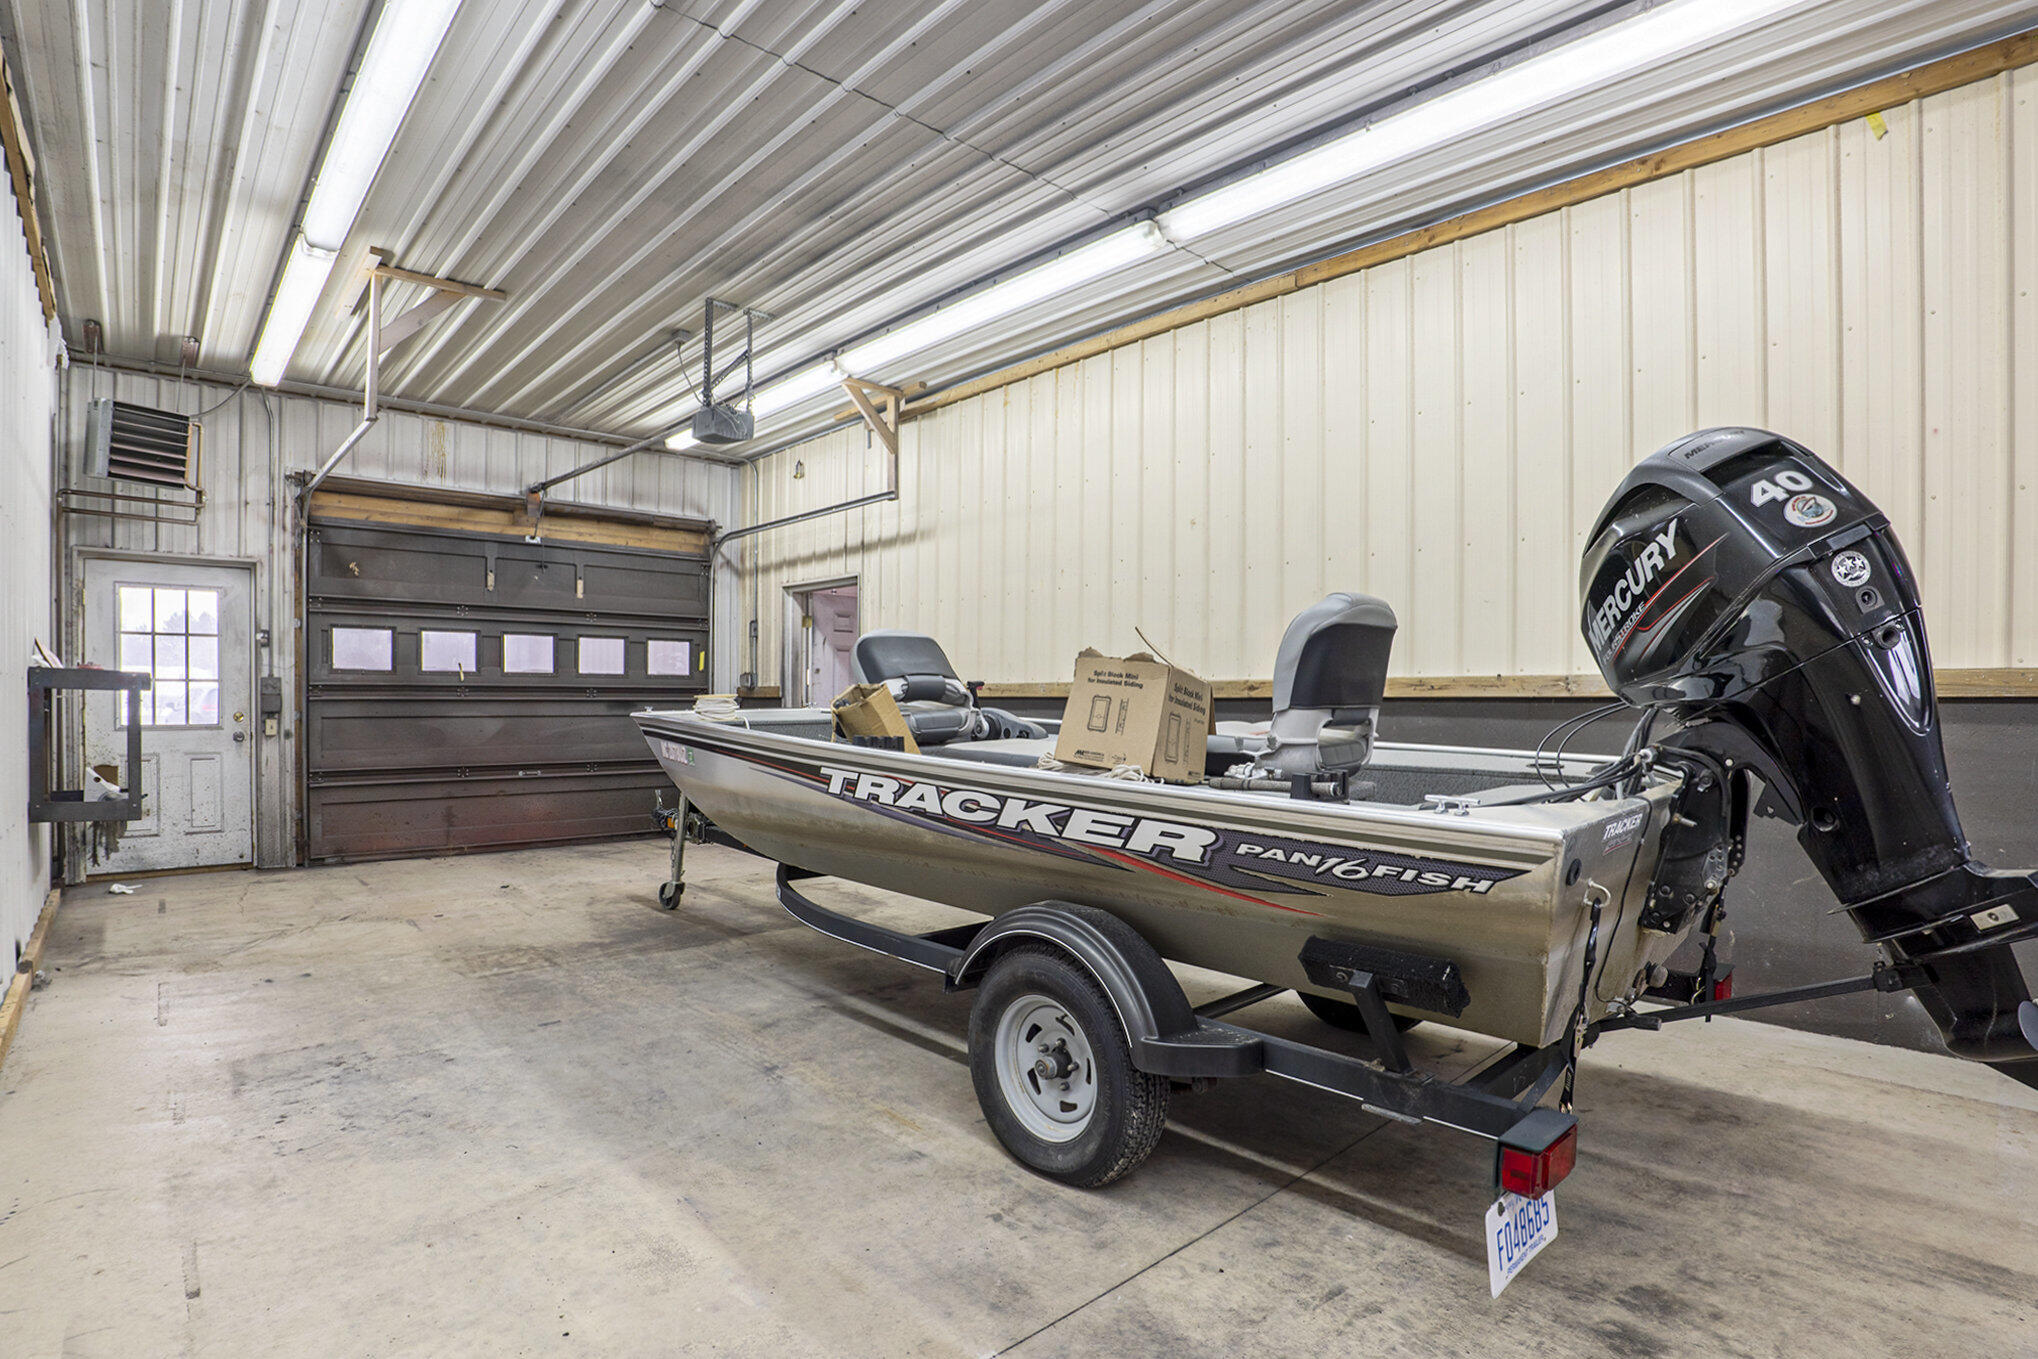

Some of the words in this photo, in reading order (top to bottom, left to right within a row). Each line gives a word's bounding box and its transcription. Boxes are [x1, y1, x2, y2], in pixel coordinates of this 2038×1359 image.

[1750, 470, 1814, 508] 40
[1588, 518, 1678, 650] MERCURY
[1097, 678, 1122, 686] Insulated
[1124, 680, 1143, 690] Siding
[1125, 672, 1139, 680] Mini
[819, 766, 1219, 863] TRACKER
[1602, 812, 1643, 841] TRACKER
